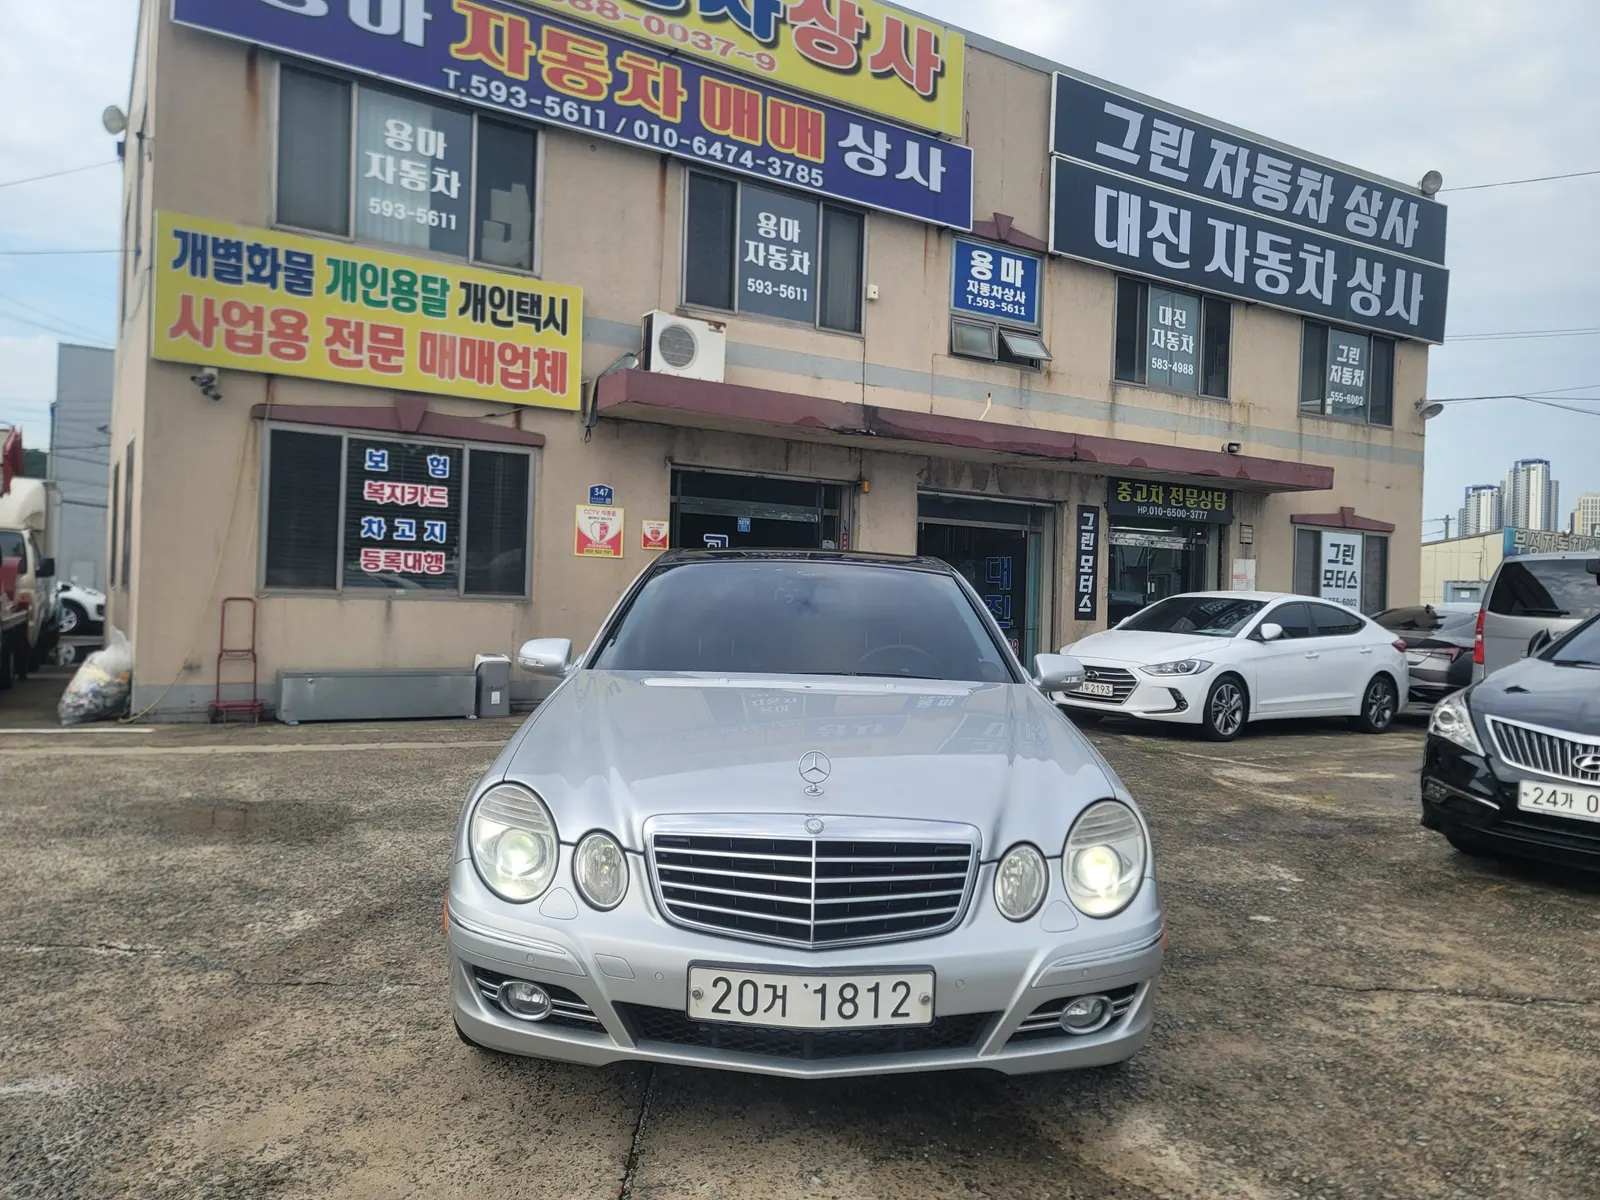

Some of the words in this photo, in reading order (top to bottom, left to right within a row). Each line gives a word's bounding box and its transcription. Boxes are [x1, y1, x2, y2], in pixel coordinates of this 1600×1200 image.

[450, 0, 688, 124] 자동차
[700, 75, 825, 164] 매매
[838, 123, 946, 193] 상사
[384, 118, 447, 160] 용마
[442, 67, 606, 131] T.593-5611
[633, 120, 824, 188] 010-6474-3785
[364, 151, 462, 200] 자동차
[1095, 101, 1196, 183] 그린
[1203, 138, 1335, 224] 자동차
[1344, 185, 1420, 249] 상사
[368, 198, 457, 230] 593-5611
[756, 212, 801, 244] 용마
[743, 240, 811, 276] 자동차
[1094, 184, 1192, 270] 대진
[1204, 217, 1337, 306] 자동차
[1347, 257, 1424, 326] 상사
[171, 229, 316, 297] 개별화물
[324, 257, 451, 319] 개인용달
[458, 281, 569, 336] 개인택시
[747, 278, 808, 302] 593-5611
[966, 279, 1026, 305] 자동차상사
[966, 295, 1026, 316] T.593-5611
[1158, 305, 1187, 329] 대진
[169, 294, 309, 361] 사업용
[324, 316, 406, 374] 전문
[418, 331, 569, 396] 매매업체
[1151, 327, 1194, 354] 자동차
[1336, 344, 1361, 365] 그린
[1151, 357, 1194, 376] 583-4988
[1329, 364, 1365, 387] 자동차
[1330, 391, 1364, 406] 555-6002
[363, 479, 449, 509] 복지카드
[594, 487, 609, 497] 347
[1117, 481, 1164, 505] 중고차
[1169, 486, 1227, 511] 전문상담
[1081, 512, 1094, 551] 그린
[360, 548, 446, 575] 등록대행
[1327, 543, 1356, 566] 그린
[1078, 555, 1094, 613] 모터스
[1322, 569, 1358, 590] 모터스
[1091, 684, 1111, 695] 2193
[1533, 786, 1574, 809] 24가
[711, 976, 788, 1018] 20거
[813, 980, 912, 1021] 1812
